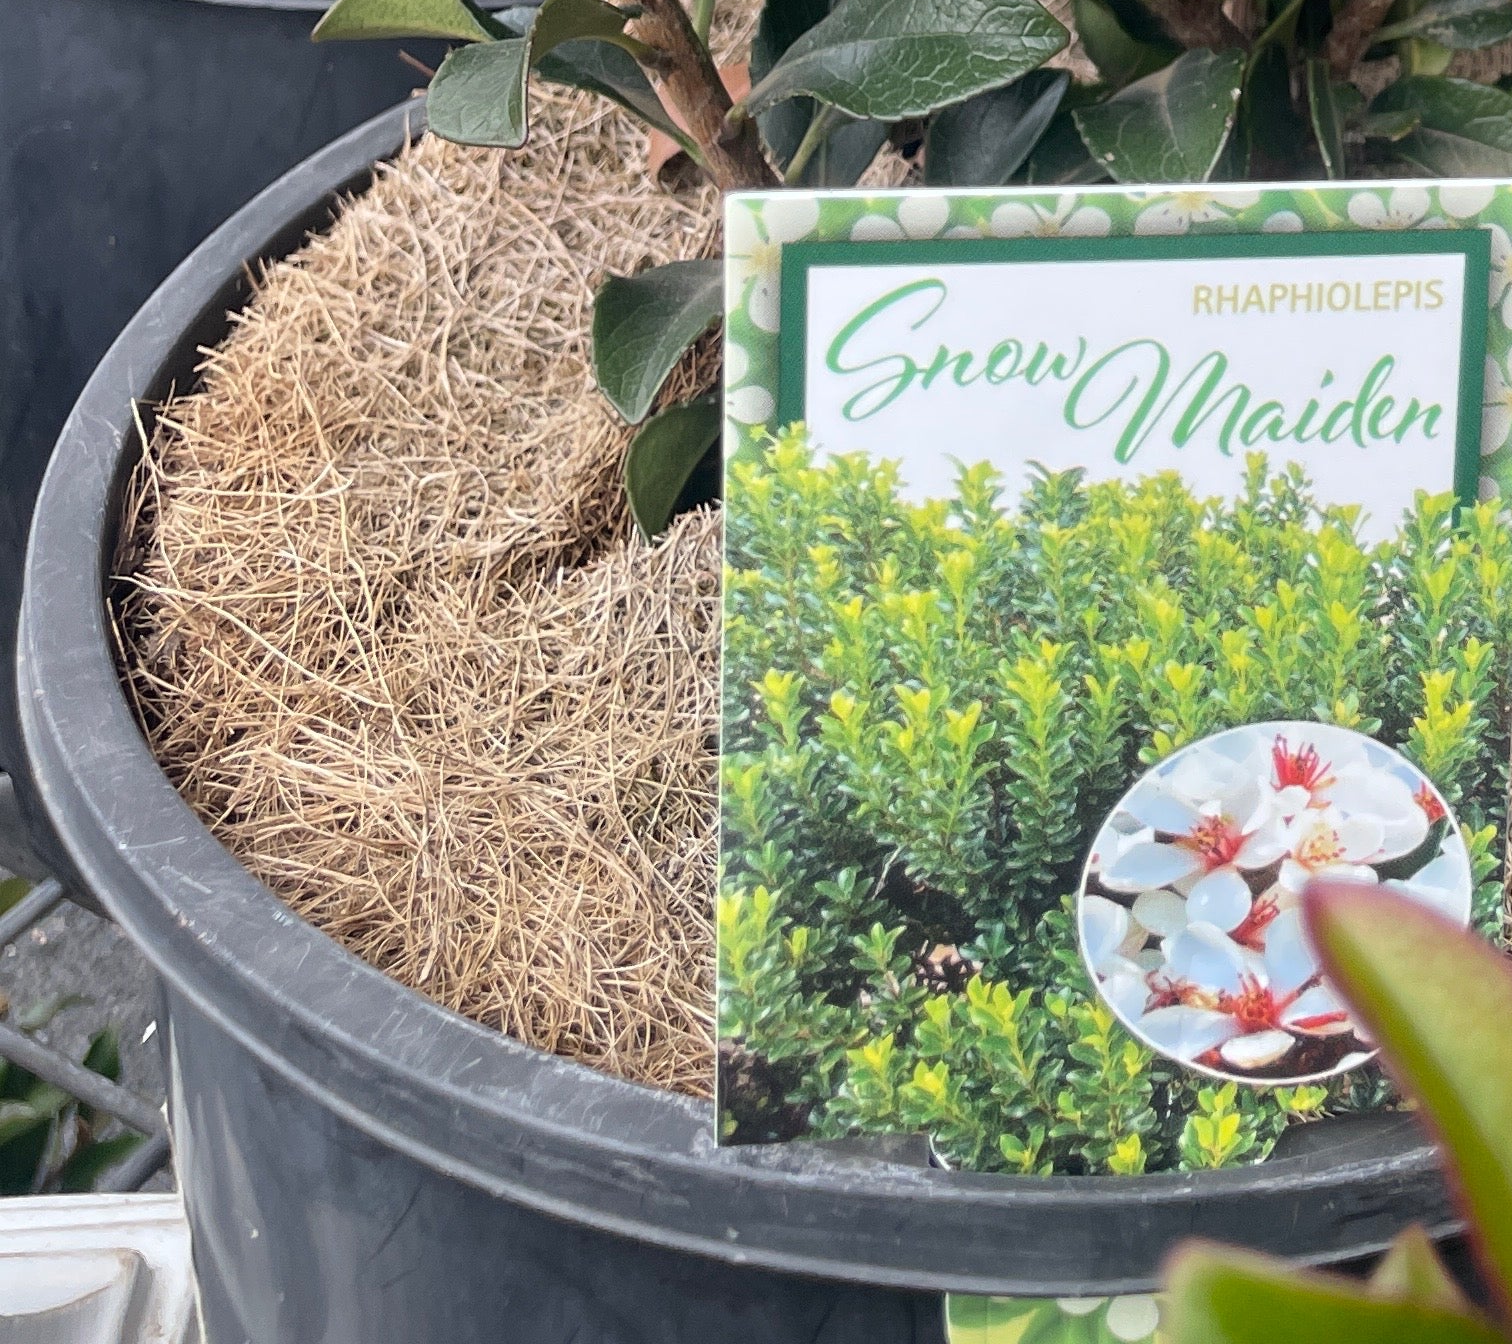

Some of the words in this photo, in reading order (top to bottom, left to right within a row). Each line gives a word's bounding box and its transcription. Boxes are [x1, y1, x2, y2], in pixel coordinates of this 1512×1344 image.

[1193, 279, 1444, 315] RHAPHIOLEPIS
[826, 278, 1088, 422] Snow
[1065, 339, 1443, 464] Maiden
